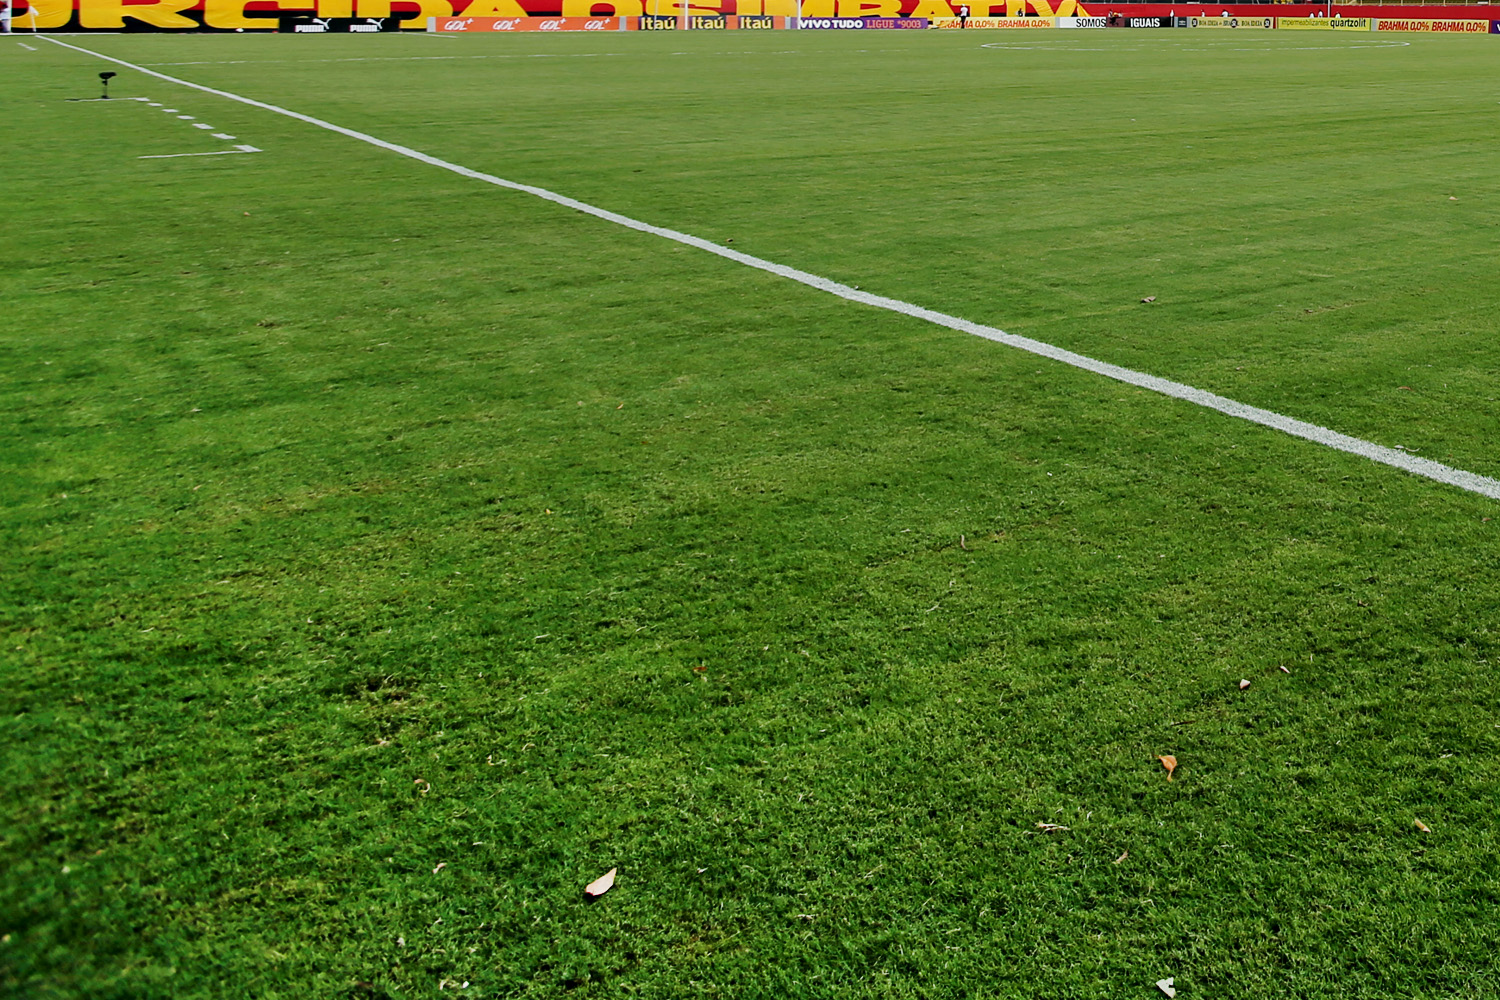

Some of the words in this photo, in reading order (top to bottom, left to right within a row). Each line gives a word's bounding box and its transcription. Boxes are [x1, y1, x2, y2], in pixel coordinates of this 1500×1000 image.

[640, 16, 676, 30] Itaú
[691, 16, 724, 30] Itaú
[740, 16, 771, 30] Itaú
[799, 19, 831, 29] VIVO
[832, 19, 864, 29] TUDO
[866, 19, 895, 29] LIGUE
[998, 20, 1031, 29] BRAHMA
[1076, 17, 1106, 28] SOMOS
[1130, 17, 1160, 28] IGUAIS
[1330, 18, 1366, 29] quartzolit
[1378, 20, 1409, 31] BRAHMA
[1431, 21, 1464, 32] BRAHMA
